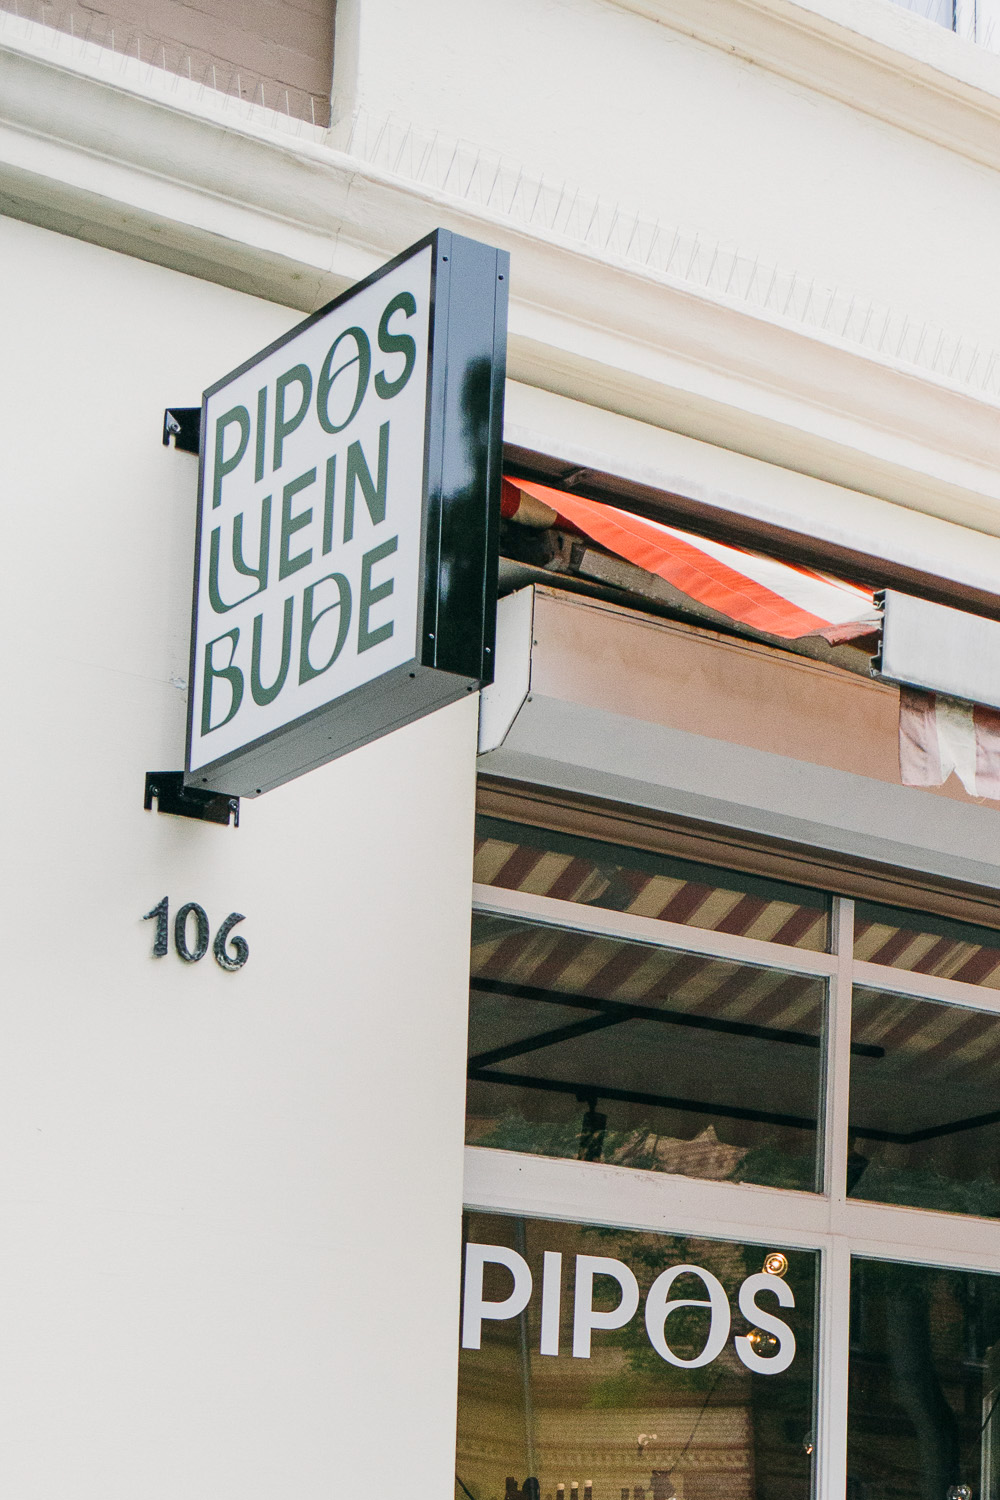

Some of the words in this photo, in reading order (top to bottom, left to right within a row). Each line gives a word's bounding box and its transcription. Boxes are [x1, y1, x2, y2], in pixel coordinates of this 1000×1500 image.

[211, 291, 418, 511] PIPOS
[208, 420, 391, 615] WEIN
[200, 534, 399, 738] BUDE
[142, 895, 249, 972] 106
[461, 1242, 797, 1375] PIPOS
